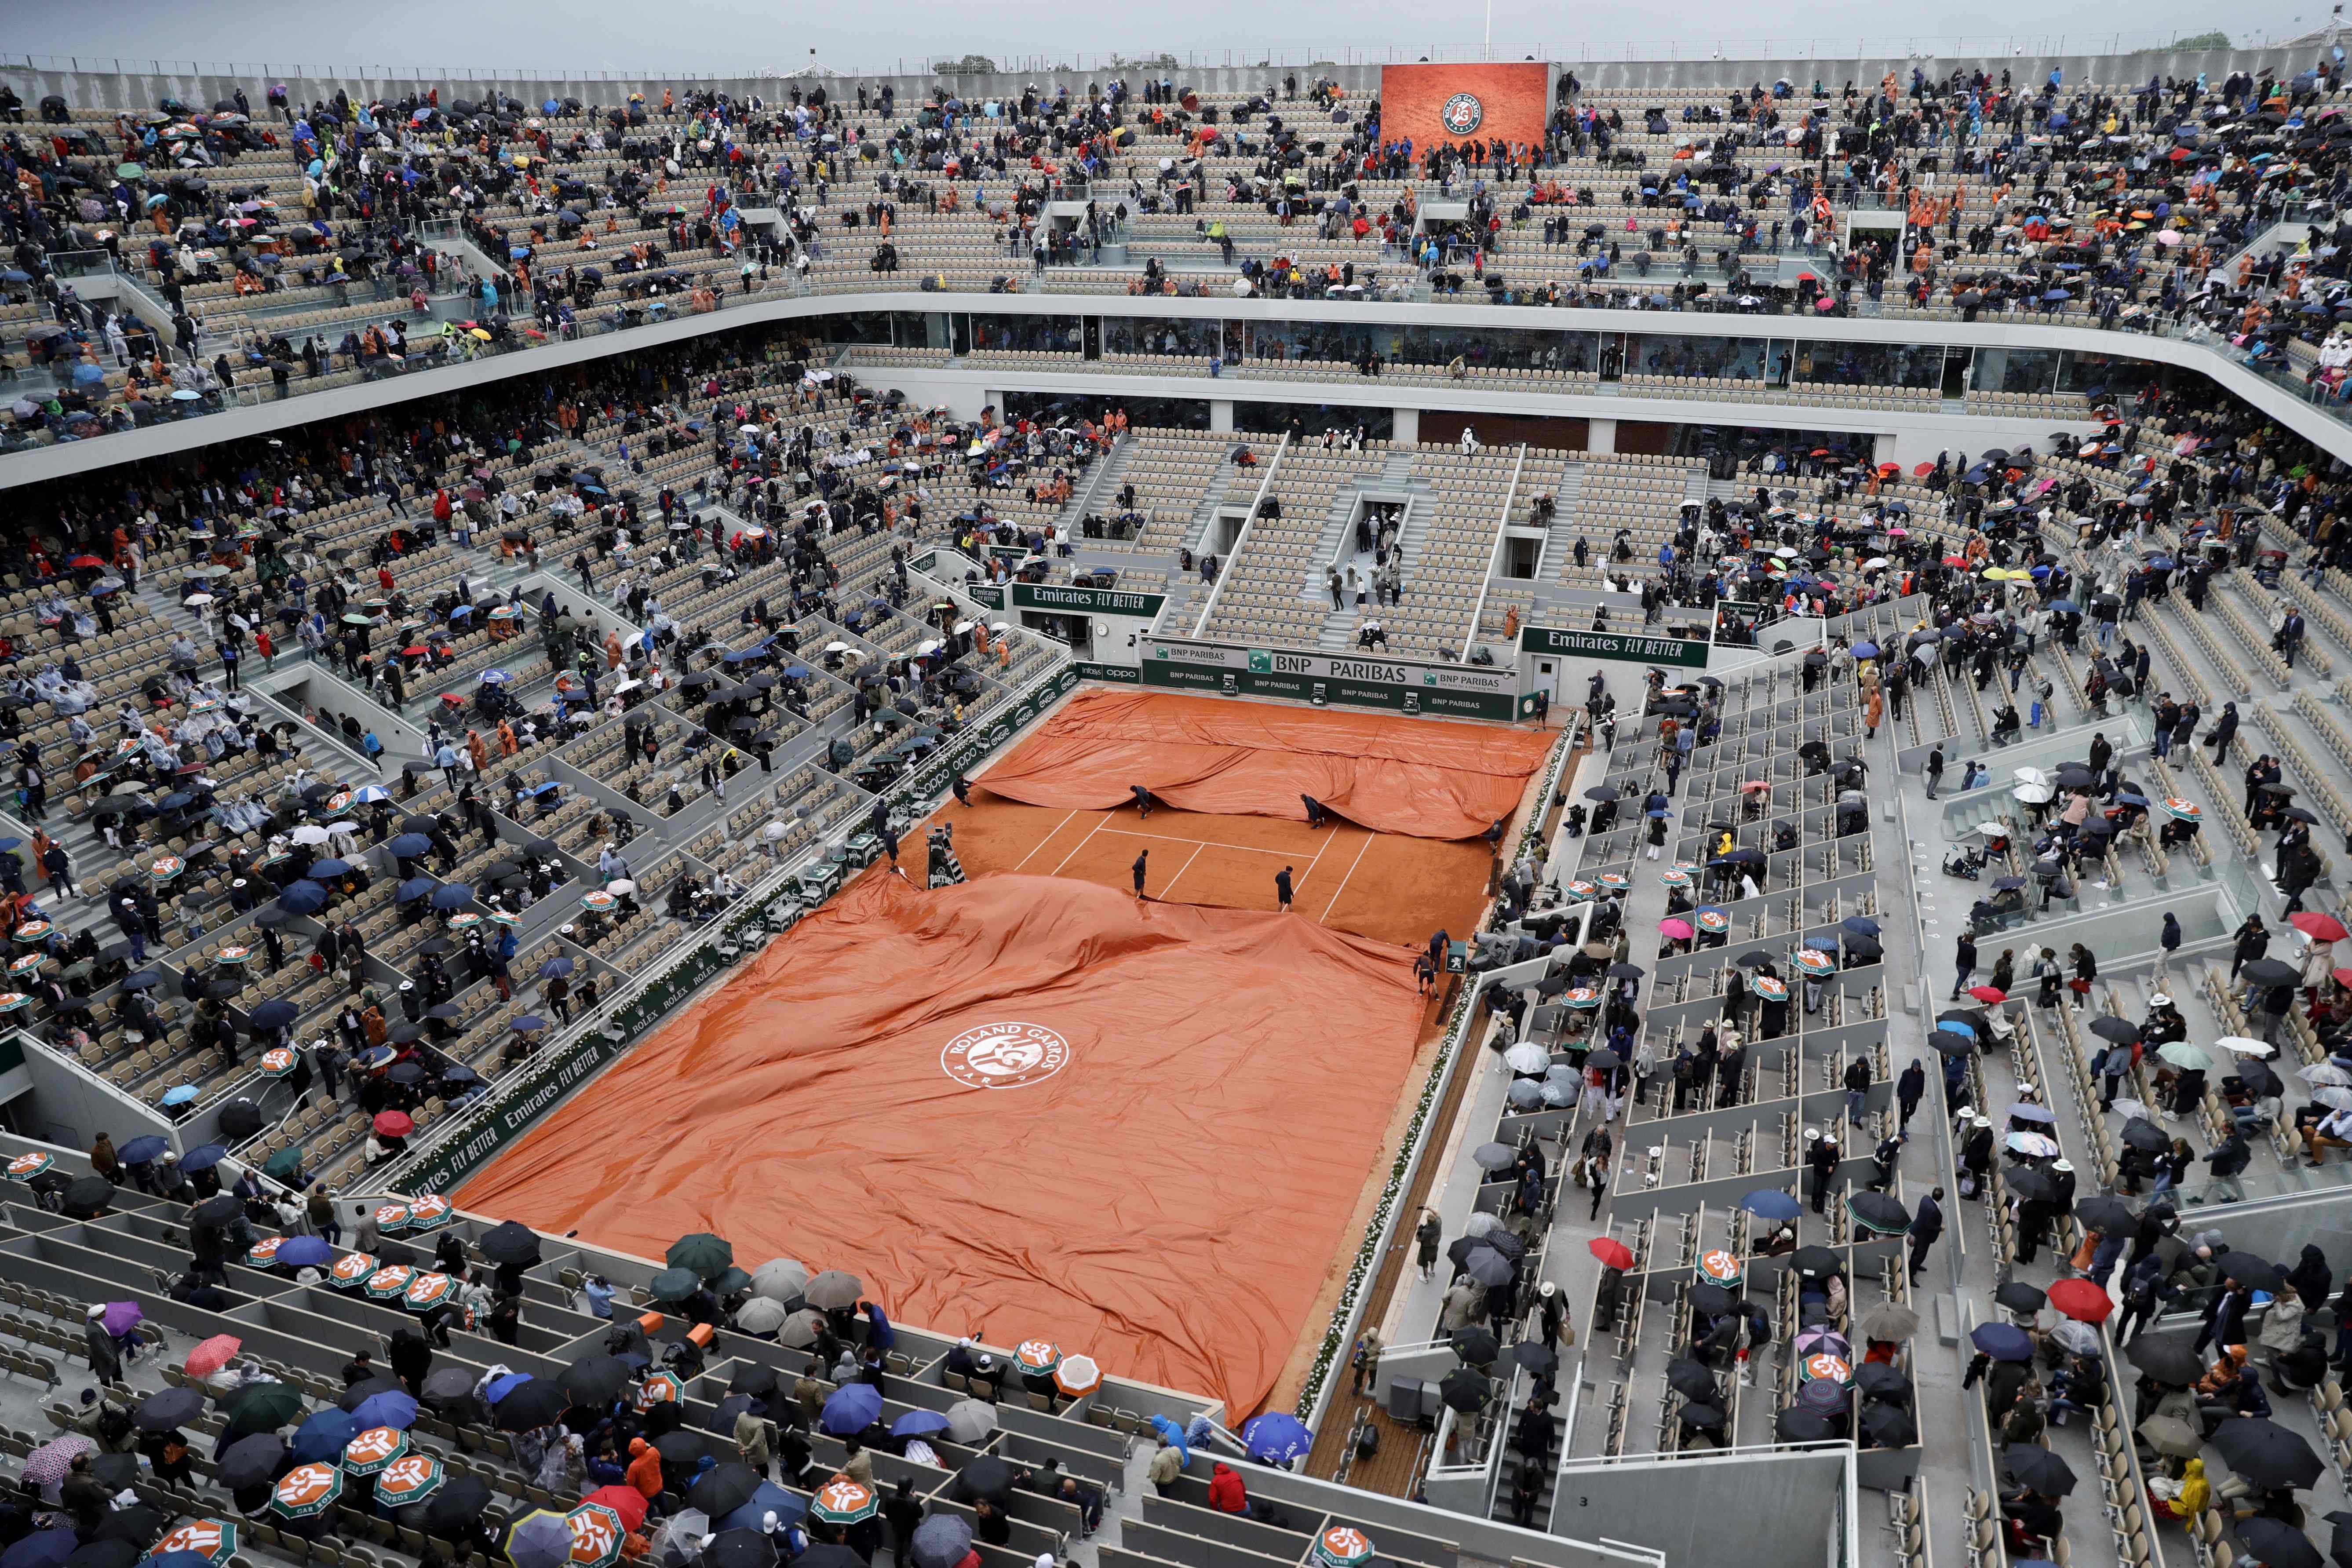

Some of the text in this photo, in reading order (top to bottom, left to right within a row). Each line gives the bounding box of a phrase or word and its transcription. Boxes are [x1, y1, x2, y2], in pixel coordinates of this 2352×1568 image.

[1445, 96, 1479, 118] ROLAND GARROS
[919, 556, 934, 570] Infosys
[972, 588, 999, 597] Emirates
[1033, 587, 1144, 609] Emirates FLY BETTER
[1549, 631, 1683, 657] Emirates FLY BETTER
[1171, 648, 1225, 660] BNP PARIBAS
[1082, 667, 1101, 676] Infosys
[1106, 669, 1136, 678] oppo
[1276, 656, 1406, 683] BNP PARIBAS
[1185, 673, 1214, 682] PARIBAS
[1440, 674, 1499, 687] BNP PARIBAS
[1270, 681, 1300, 690] PARIBAS
[1359, 690, 1388, 700] PARIBAS
[1449, 700, 1480, 709] PARIBAS
[952, 748, 977, 771] oppo
[924, 768, 950, 794] oppo
[929, 873, 955, 889] perrier
[734, 916, 765, 945] Infosys
[693, 963, 718, 986] ROLEX
[1797, 962, 1819, 973] GARROS
[663, 986, 689, 1010] ROLEX
[0, 1002, 21, 1010] OLAND
[632, 1010, 659, 1034] ROLEX
[950, 1025, 1063, 1070] ROLAND GARROS
[503, 1045, 600, 1129] Emirates FLY BETTER
[409, 1127, 499, 1199] irates FLY BETTER
[414, 1216, 440, 1226] GARROS
[1700, 1269, 1723, 1285] ROLAND
[376, 1287, 401, 1297] GARROS
[431, 1287, 452, 1305] GARROS
[347, 1463, 379, 1473] GARROS
[296, 1493, 332, 1514] GARROS
[379, 1490, 409, 1503] GARROS
[1579, 1496, 1588, 1507] 3
[1322, 1550, 1349, 1565] ROLAND
